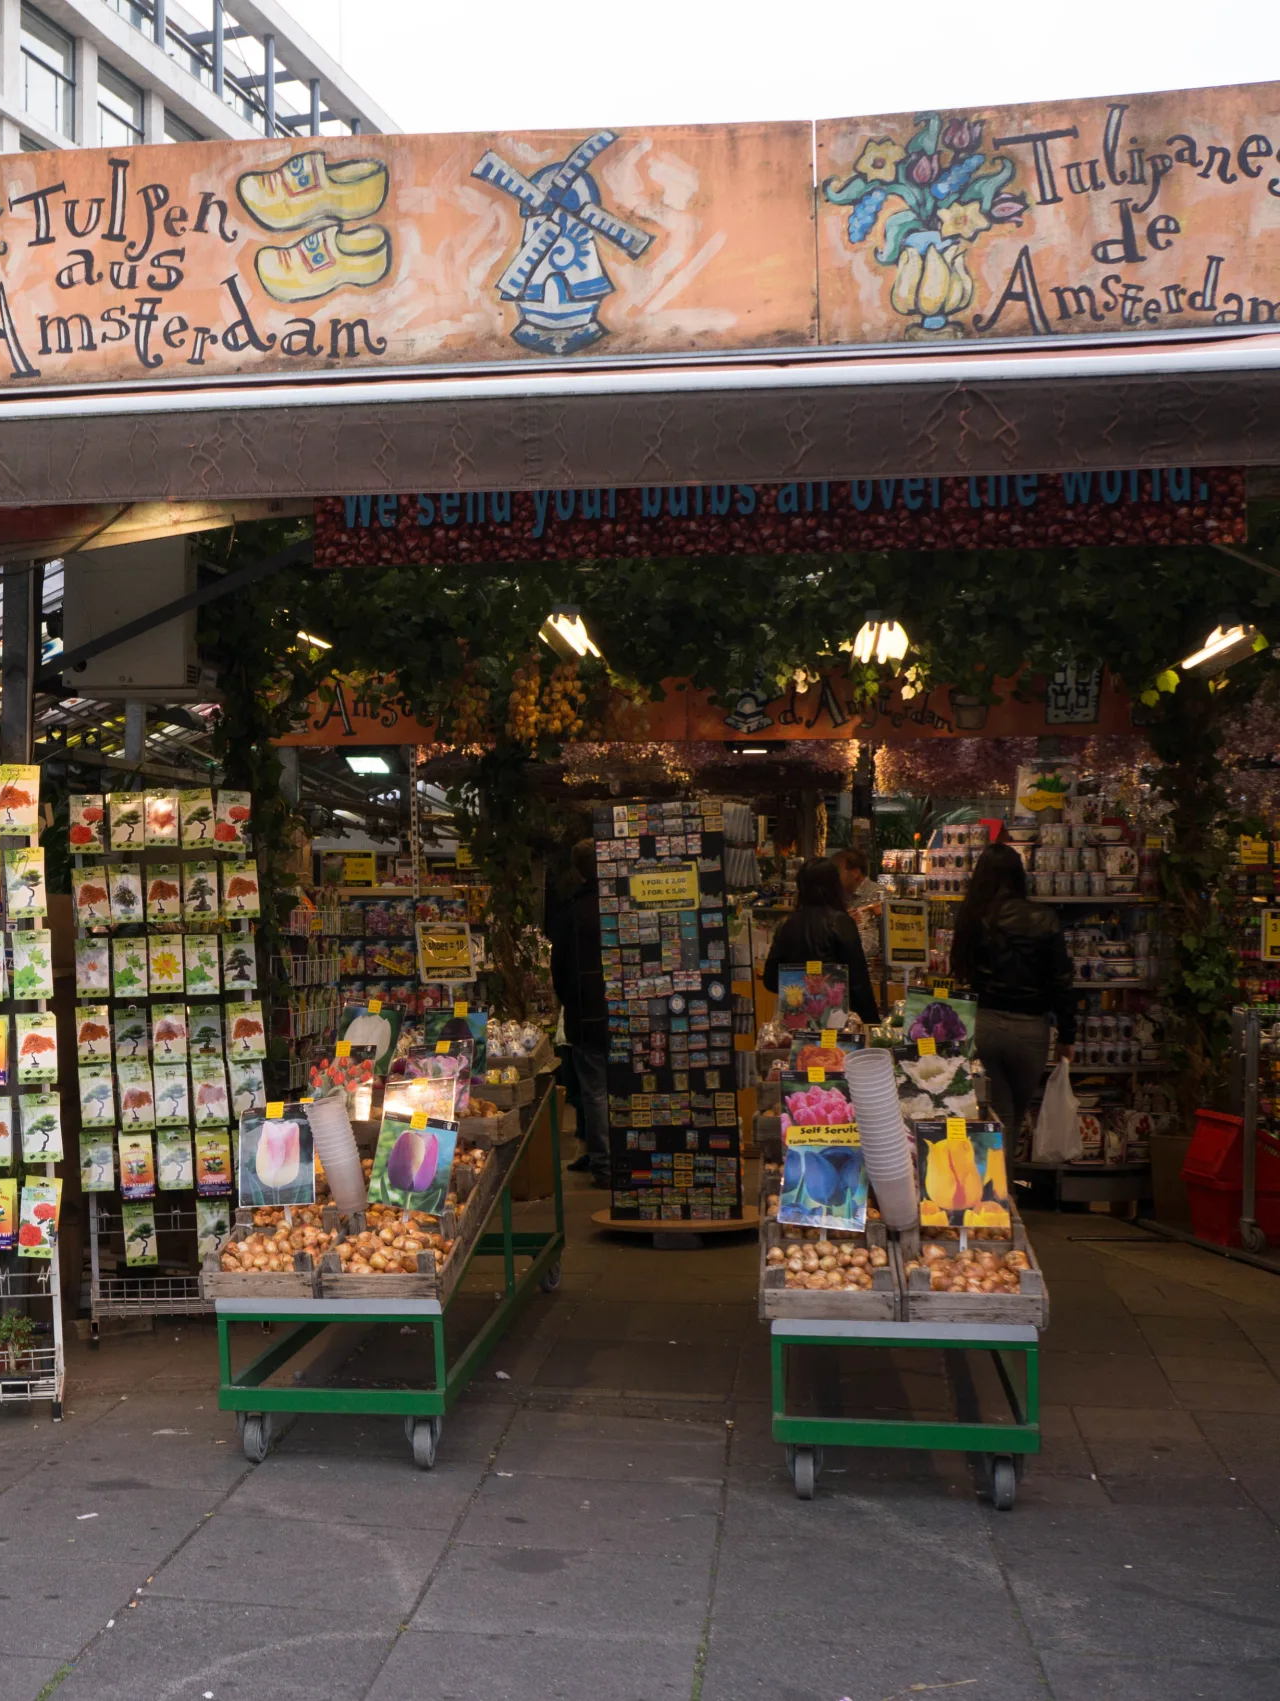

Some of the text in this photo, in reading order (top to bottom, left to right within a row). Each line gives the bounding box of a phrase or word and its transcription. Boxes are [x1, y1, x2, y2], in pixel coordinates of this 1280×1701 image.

[10, 158, 239, 262] Tulpen
[1091, 198, 1181, 264] de
[56, 247, 186, 292] aus
[974, 246, 1280, 336] Amsterdam
[418, 490, 511, 526] send
[532, 487, 616, 538] your
[825, 1125, 859, 1134] Servic
